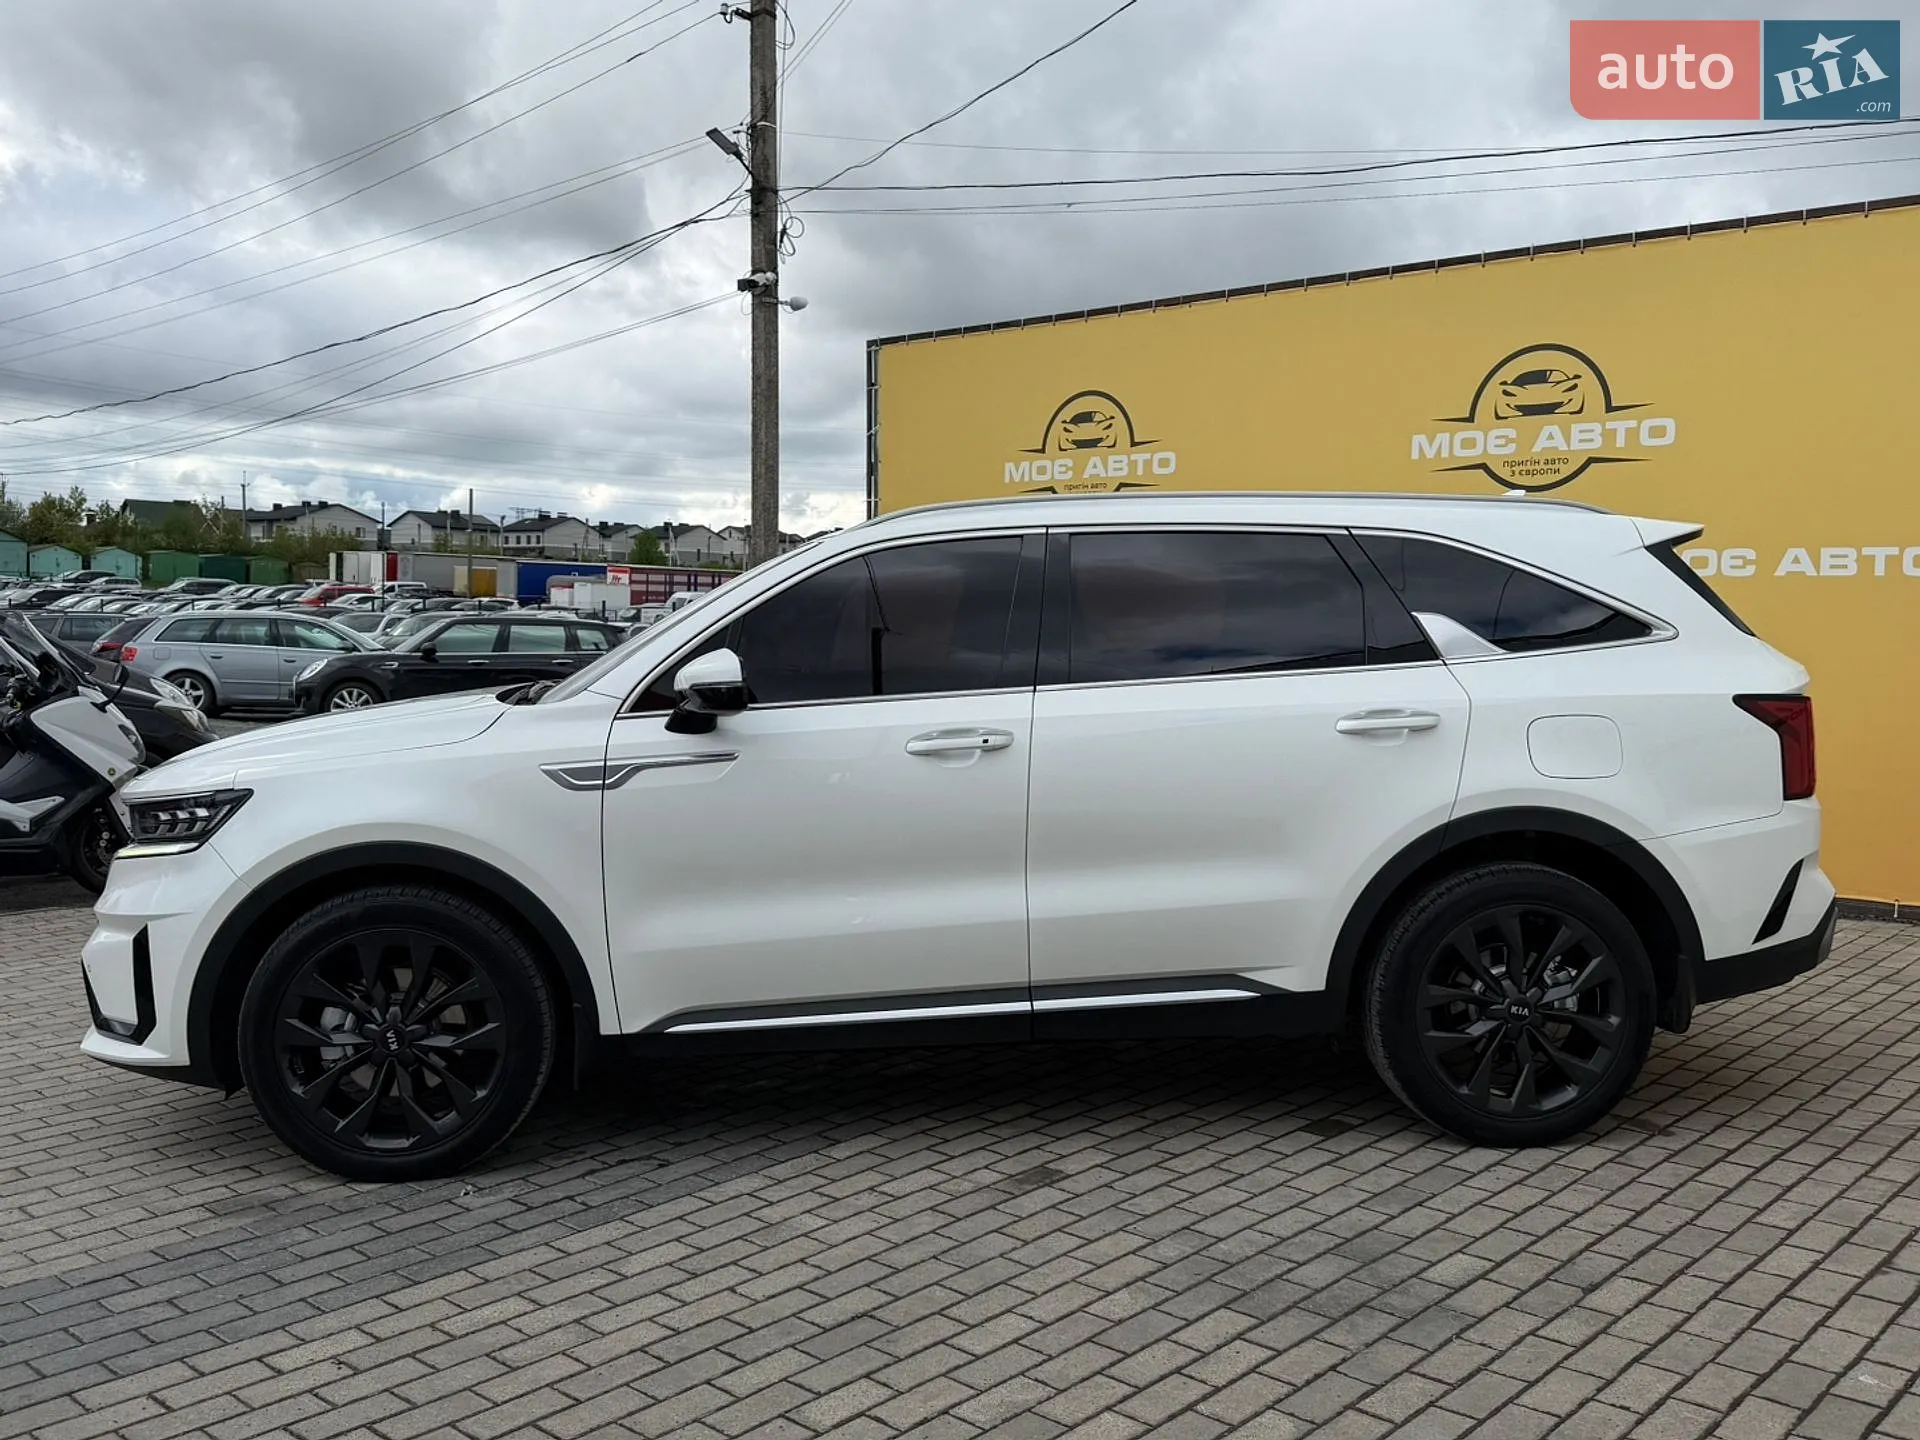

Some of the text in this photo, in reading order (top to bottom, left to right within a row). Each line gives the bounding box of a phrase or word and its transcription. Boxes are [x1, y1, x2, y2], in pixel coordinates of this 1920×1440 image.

[1411, 417, 1676, 460] МОЄ АВТО
[1004, 451, 1176, 483] МОЄ АВТО
[1502, 457, 1569, 469] пригін авто
[1680, 547, 1757, 577] ОЄ
[1510, 1005, 1529, 1016] KIA
